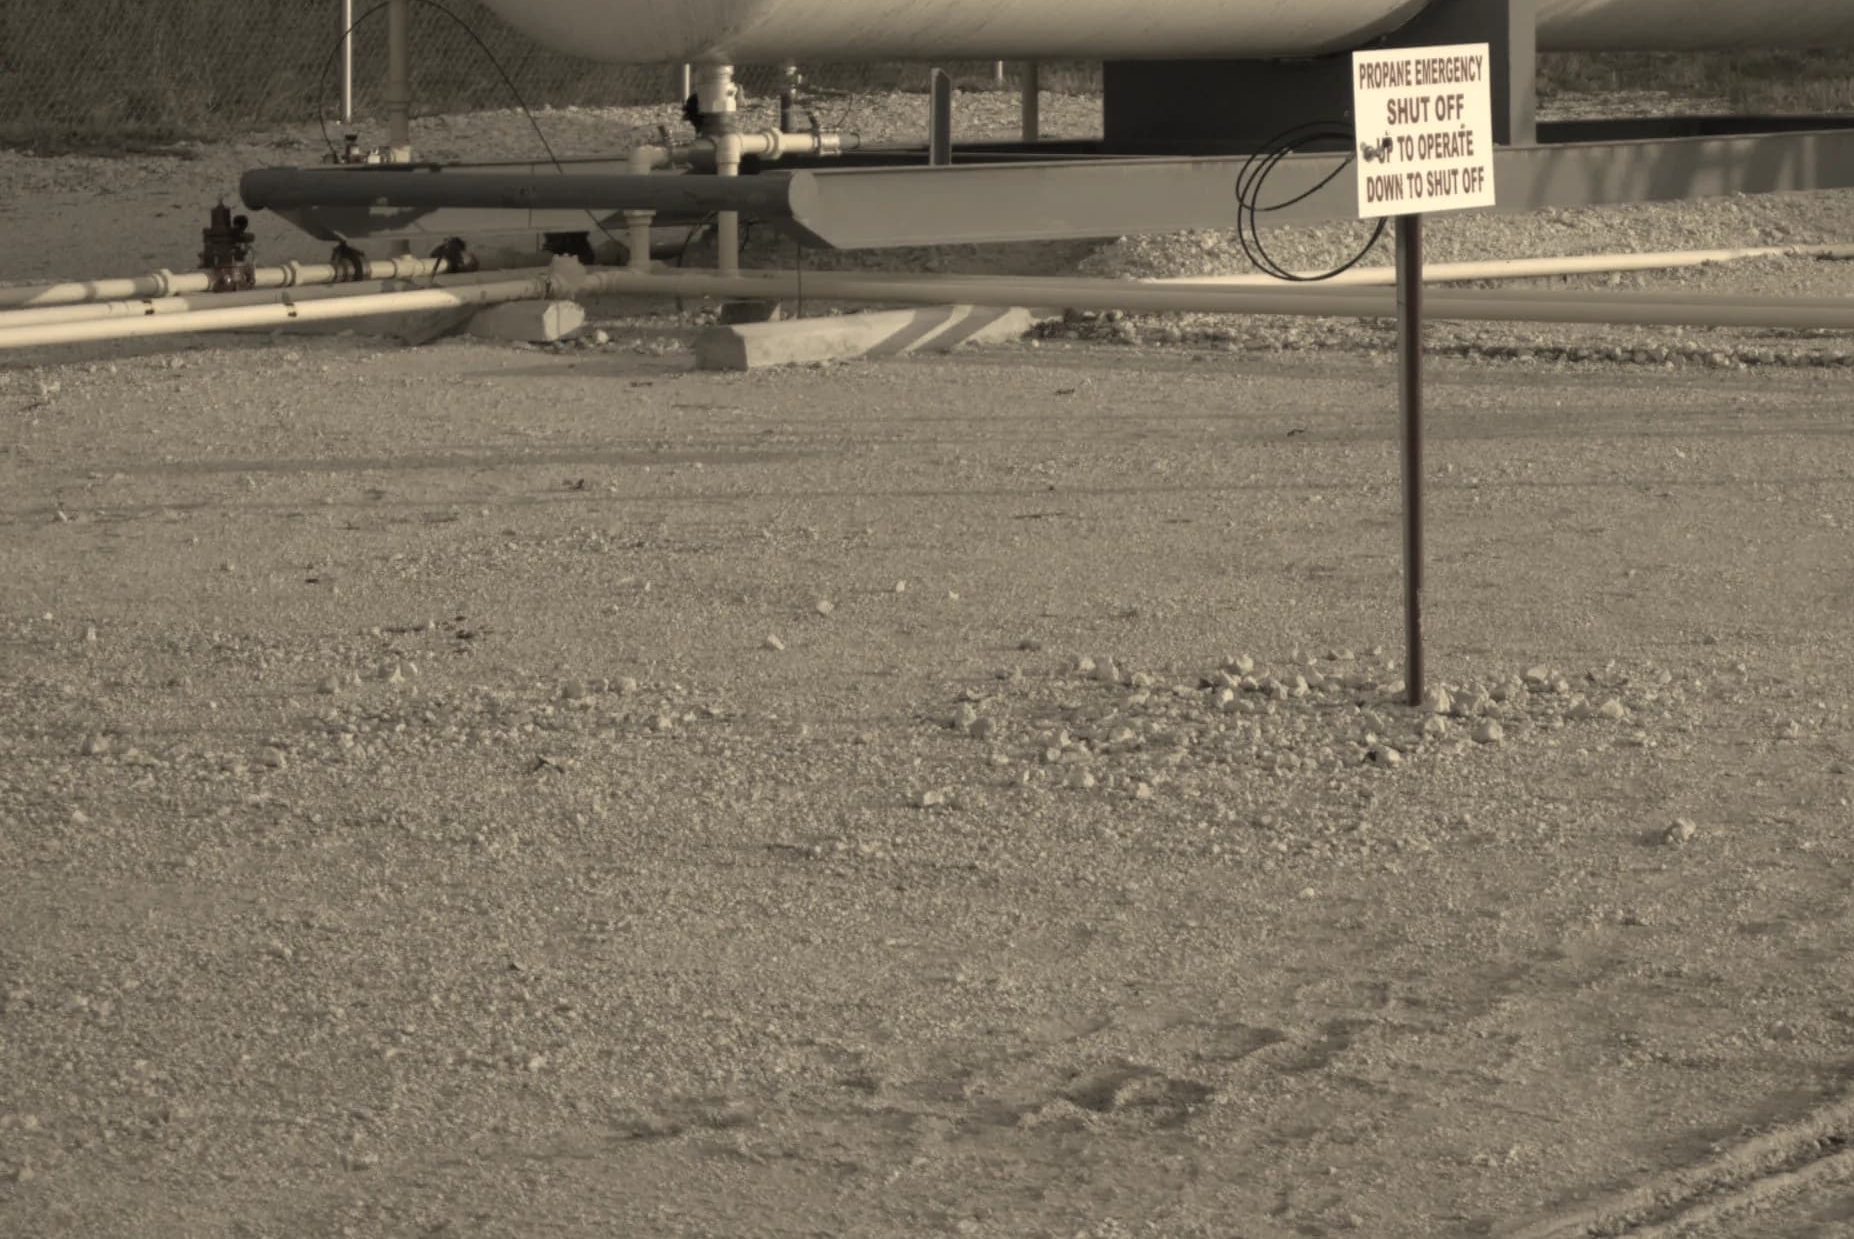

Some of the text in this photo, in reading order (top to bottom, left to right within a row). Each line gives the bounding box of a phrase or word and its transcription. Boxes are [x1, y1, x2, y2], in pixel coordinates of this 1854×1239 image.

[1359, 55, 1483, 90] PROPANE EMERGENCY
[1387, 93, 1464, 125] SHUT OFF
[1397, 135, 1414, 162] TO
[1418, 130, 1474, 160] OPERATE
[1366, 166, 1485, 203] DOWN TO SHUT OFF
